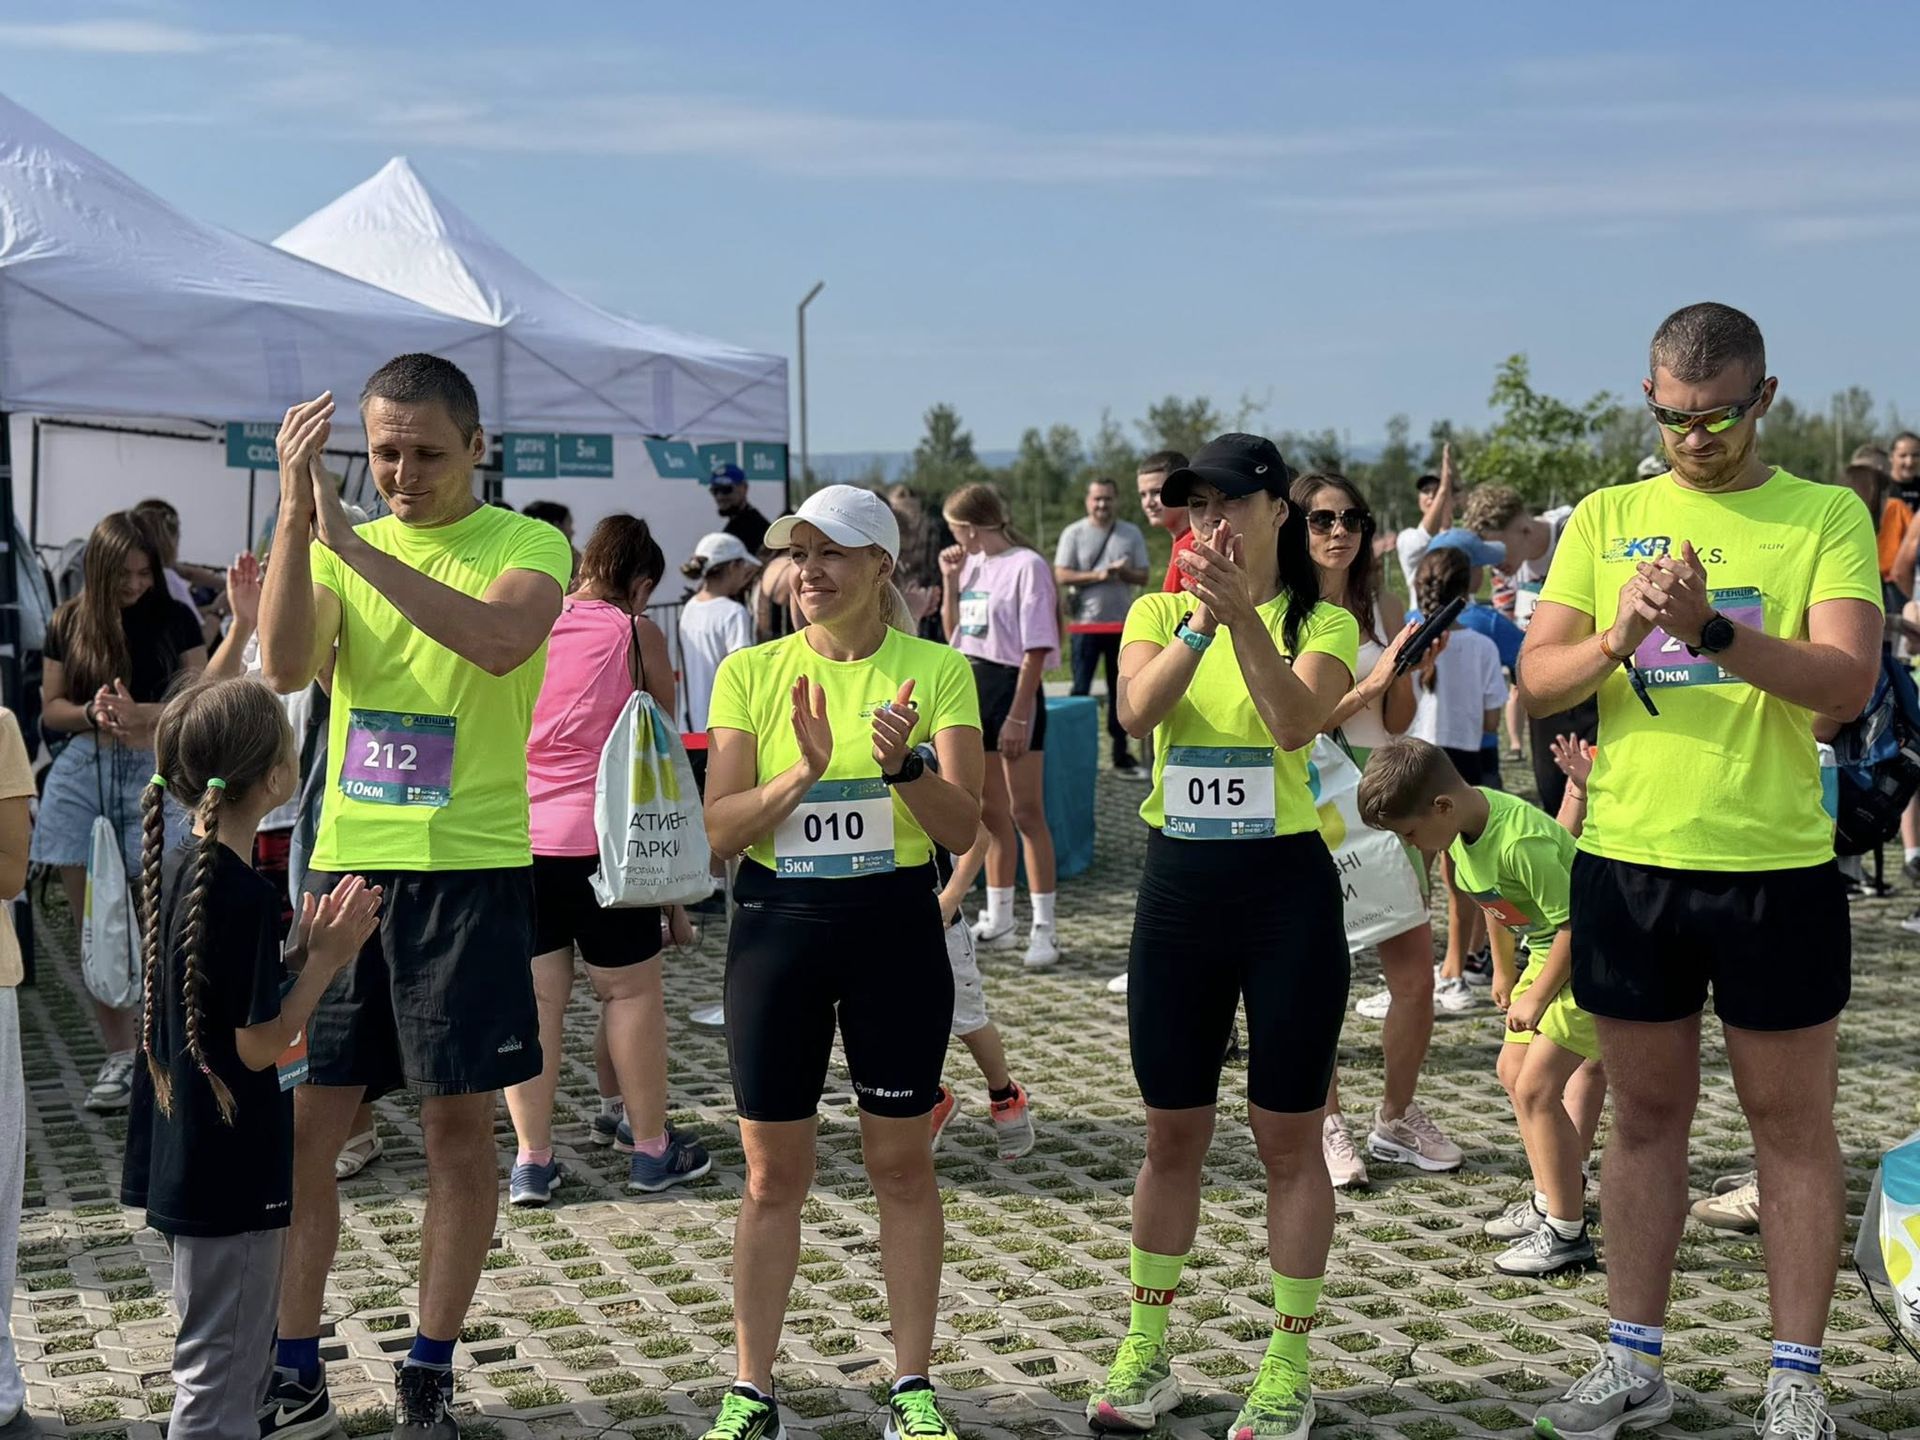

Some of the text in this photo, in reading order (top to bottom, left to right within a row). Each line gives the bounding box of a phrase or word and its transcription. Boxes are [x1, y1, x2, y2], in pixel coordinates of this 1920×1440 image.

[363, 741, 418, 770] 212
[1188, 777, 1246, 806] 015
[804, 811, 864, 843] 010
